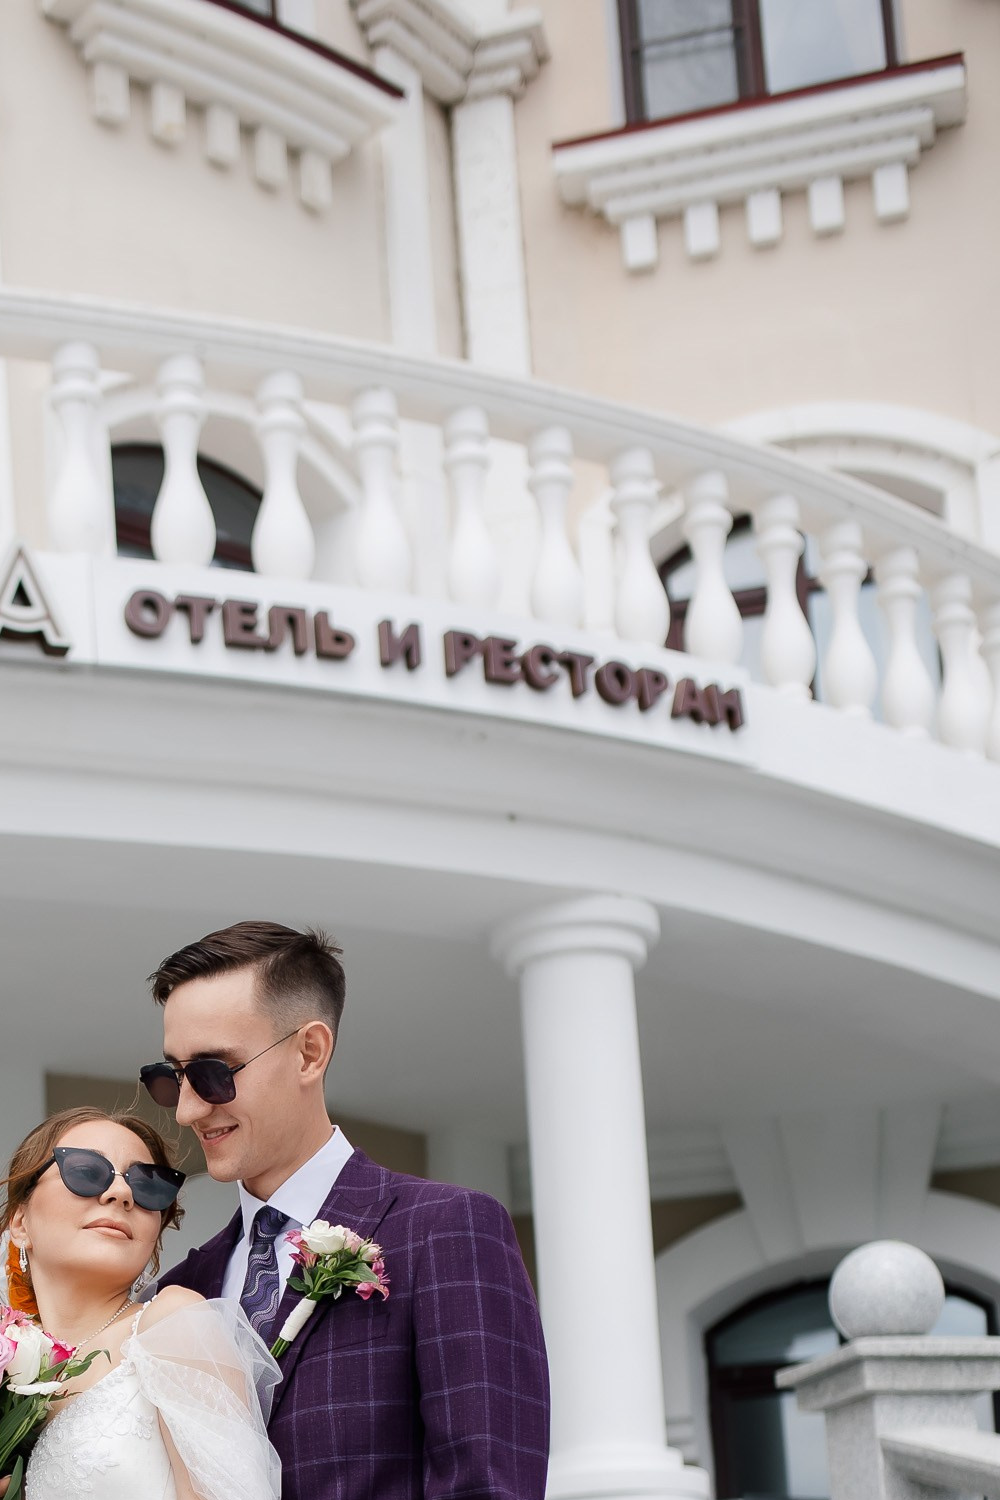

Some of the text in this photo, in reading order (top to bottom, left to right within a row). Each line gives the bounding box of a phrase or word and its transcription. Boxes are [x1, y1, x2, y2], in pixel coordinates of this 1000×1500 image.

[124, 588, 745, 732] ОТЕЛЬ И РЕСТОРАН
